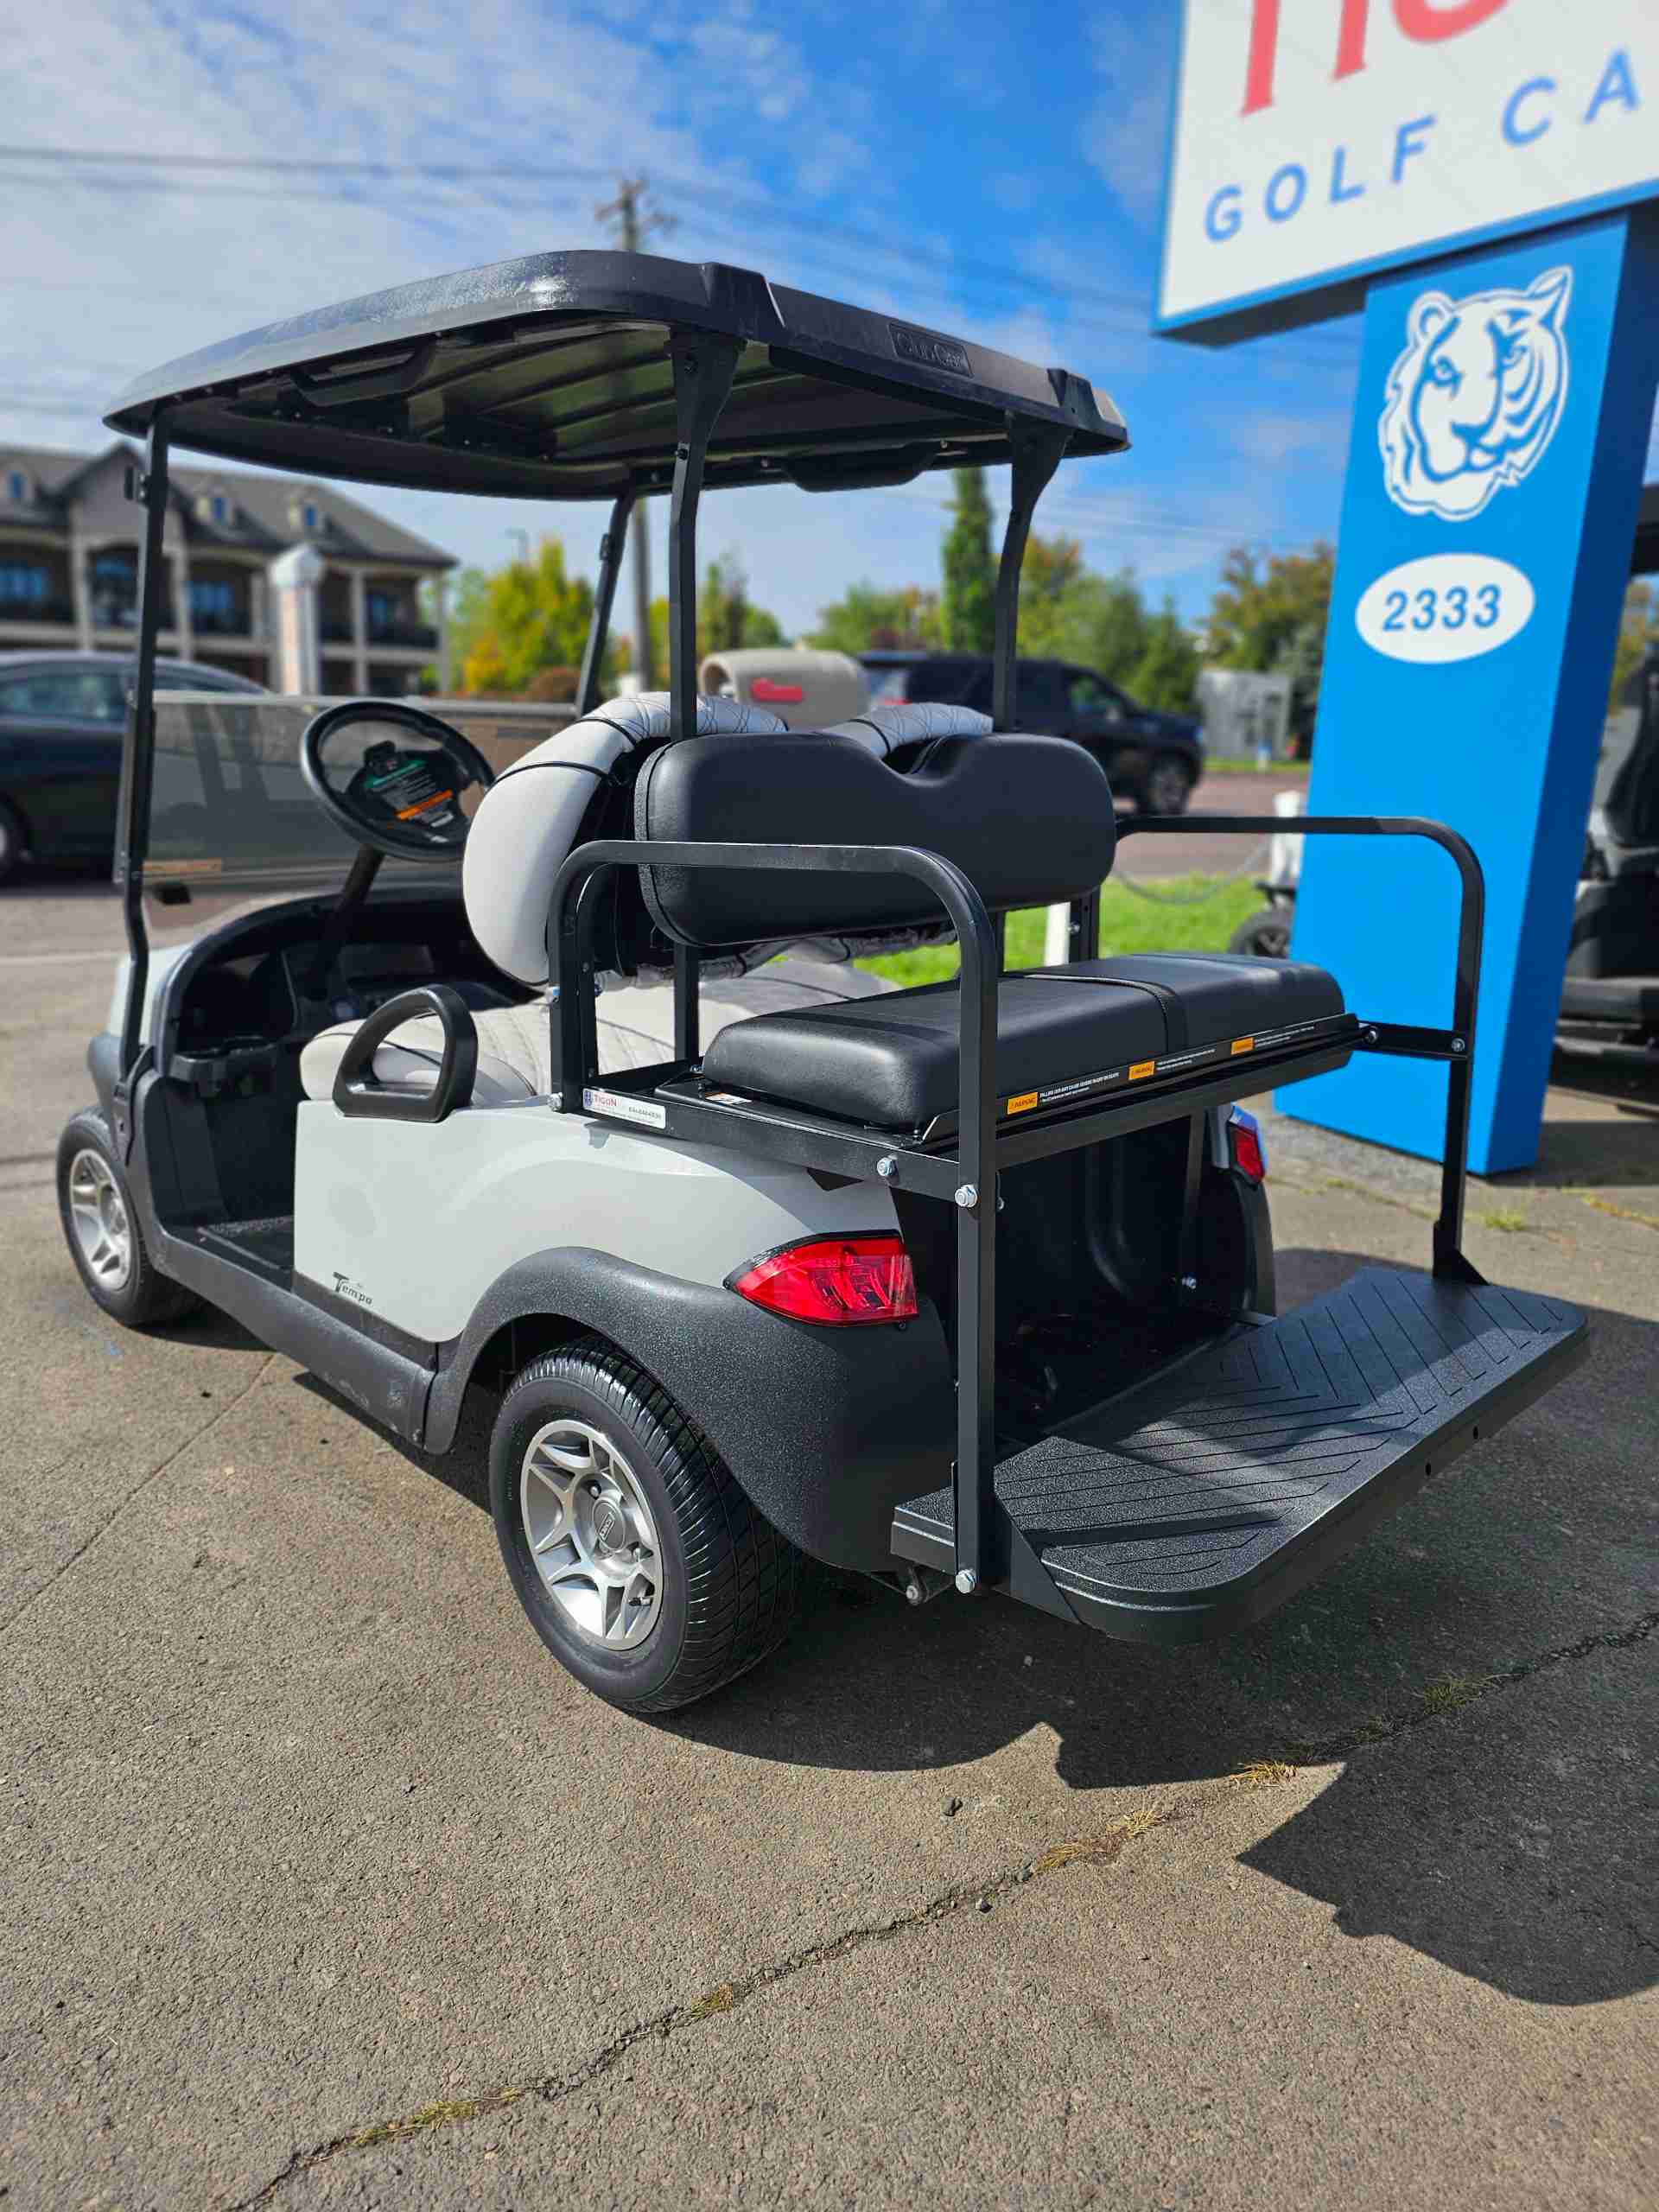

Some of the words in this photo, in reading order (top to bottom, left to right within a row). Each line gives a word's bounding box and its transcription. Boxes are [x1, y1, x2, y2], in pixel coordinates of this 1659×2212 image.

[1204, 113, 1436, 243] GOLF
[1501, 48, 1641, 147] CA
[1382, 583, 1501, 631] 2333
[333, 1271, 373, 1305] Tempo
